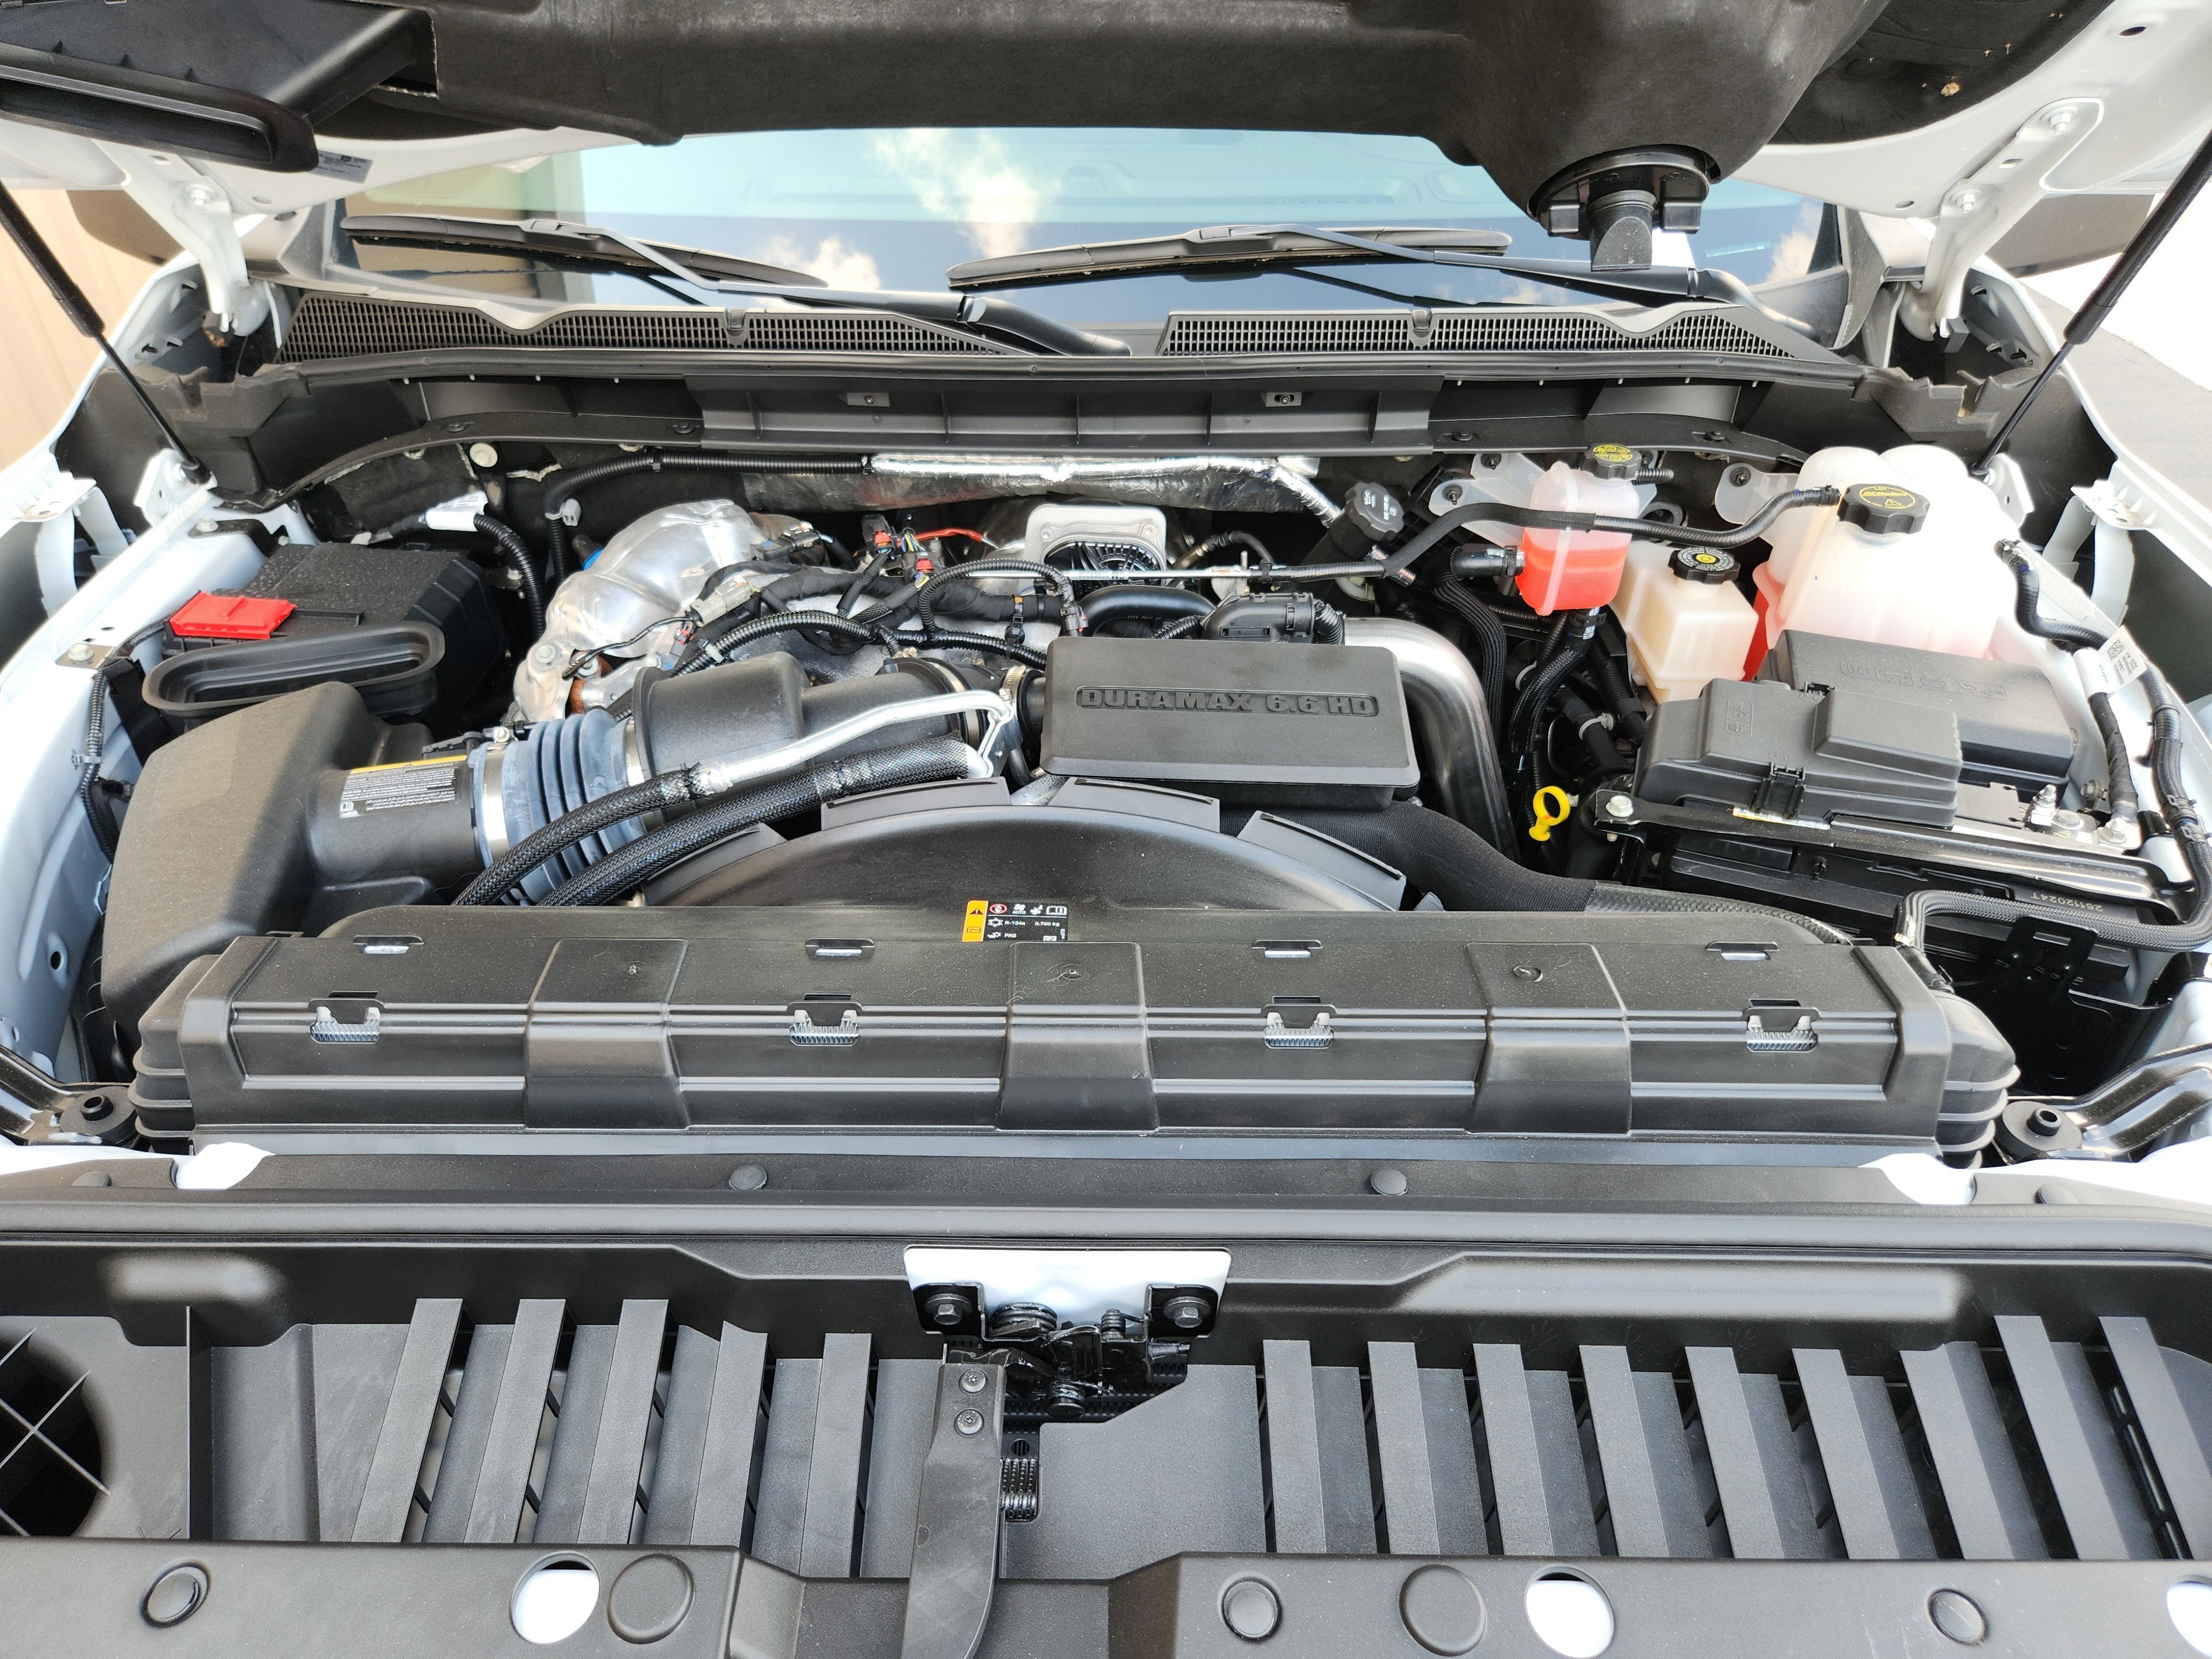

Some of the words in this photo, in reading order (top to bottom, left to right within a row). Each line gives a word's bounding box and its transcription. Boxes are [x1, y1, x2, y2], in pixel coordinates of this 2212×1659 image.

[1081, 689, 1251, 711] DURAMAX
[1266, 694, 1320, 713] 6.6
[1328, 696, 1375, 715] HD
[2031, 892, 2104, 912] 26112024T
